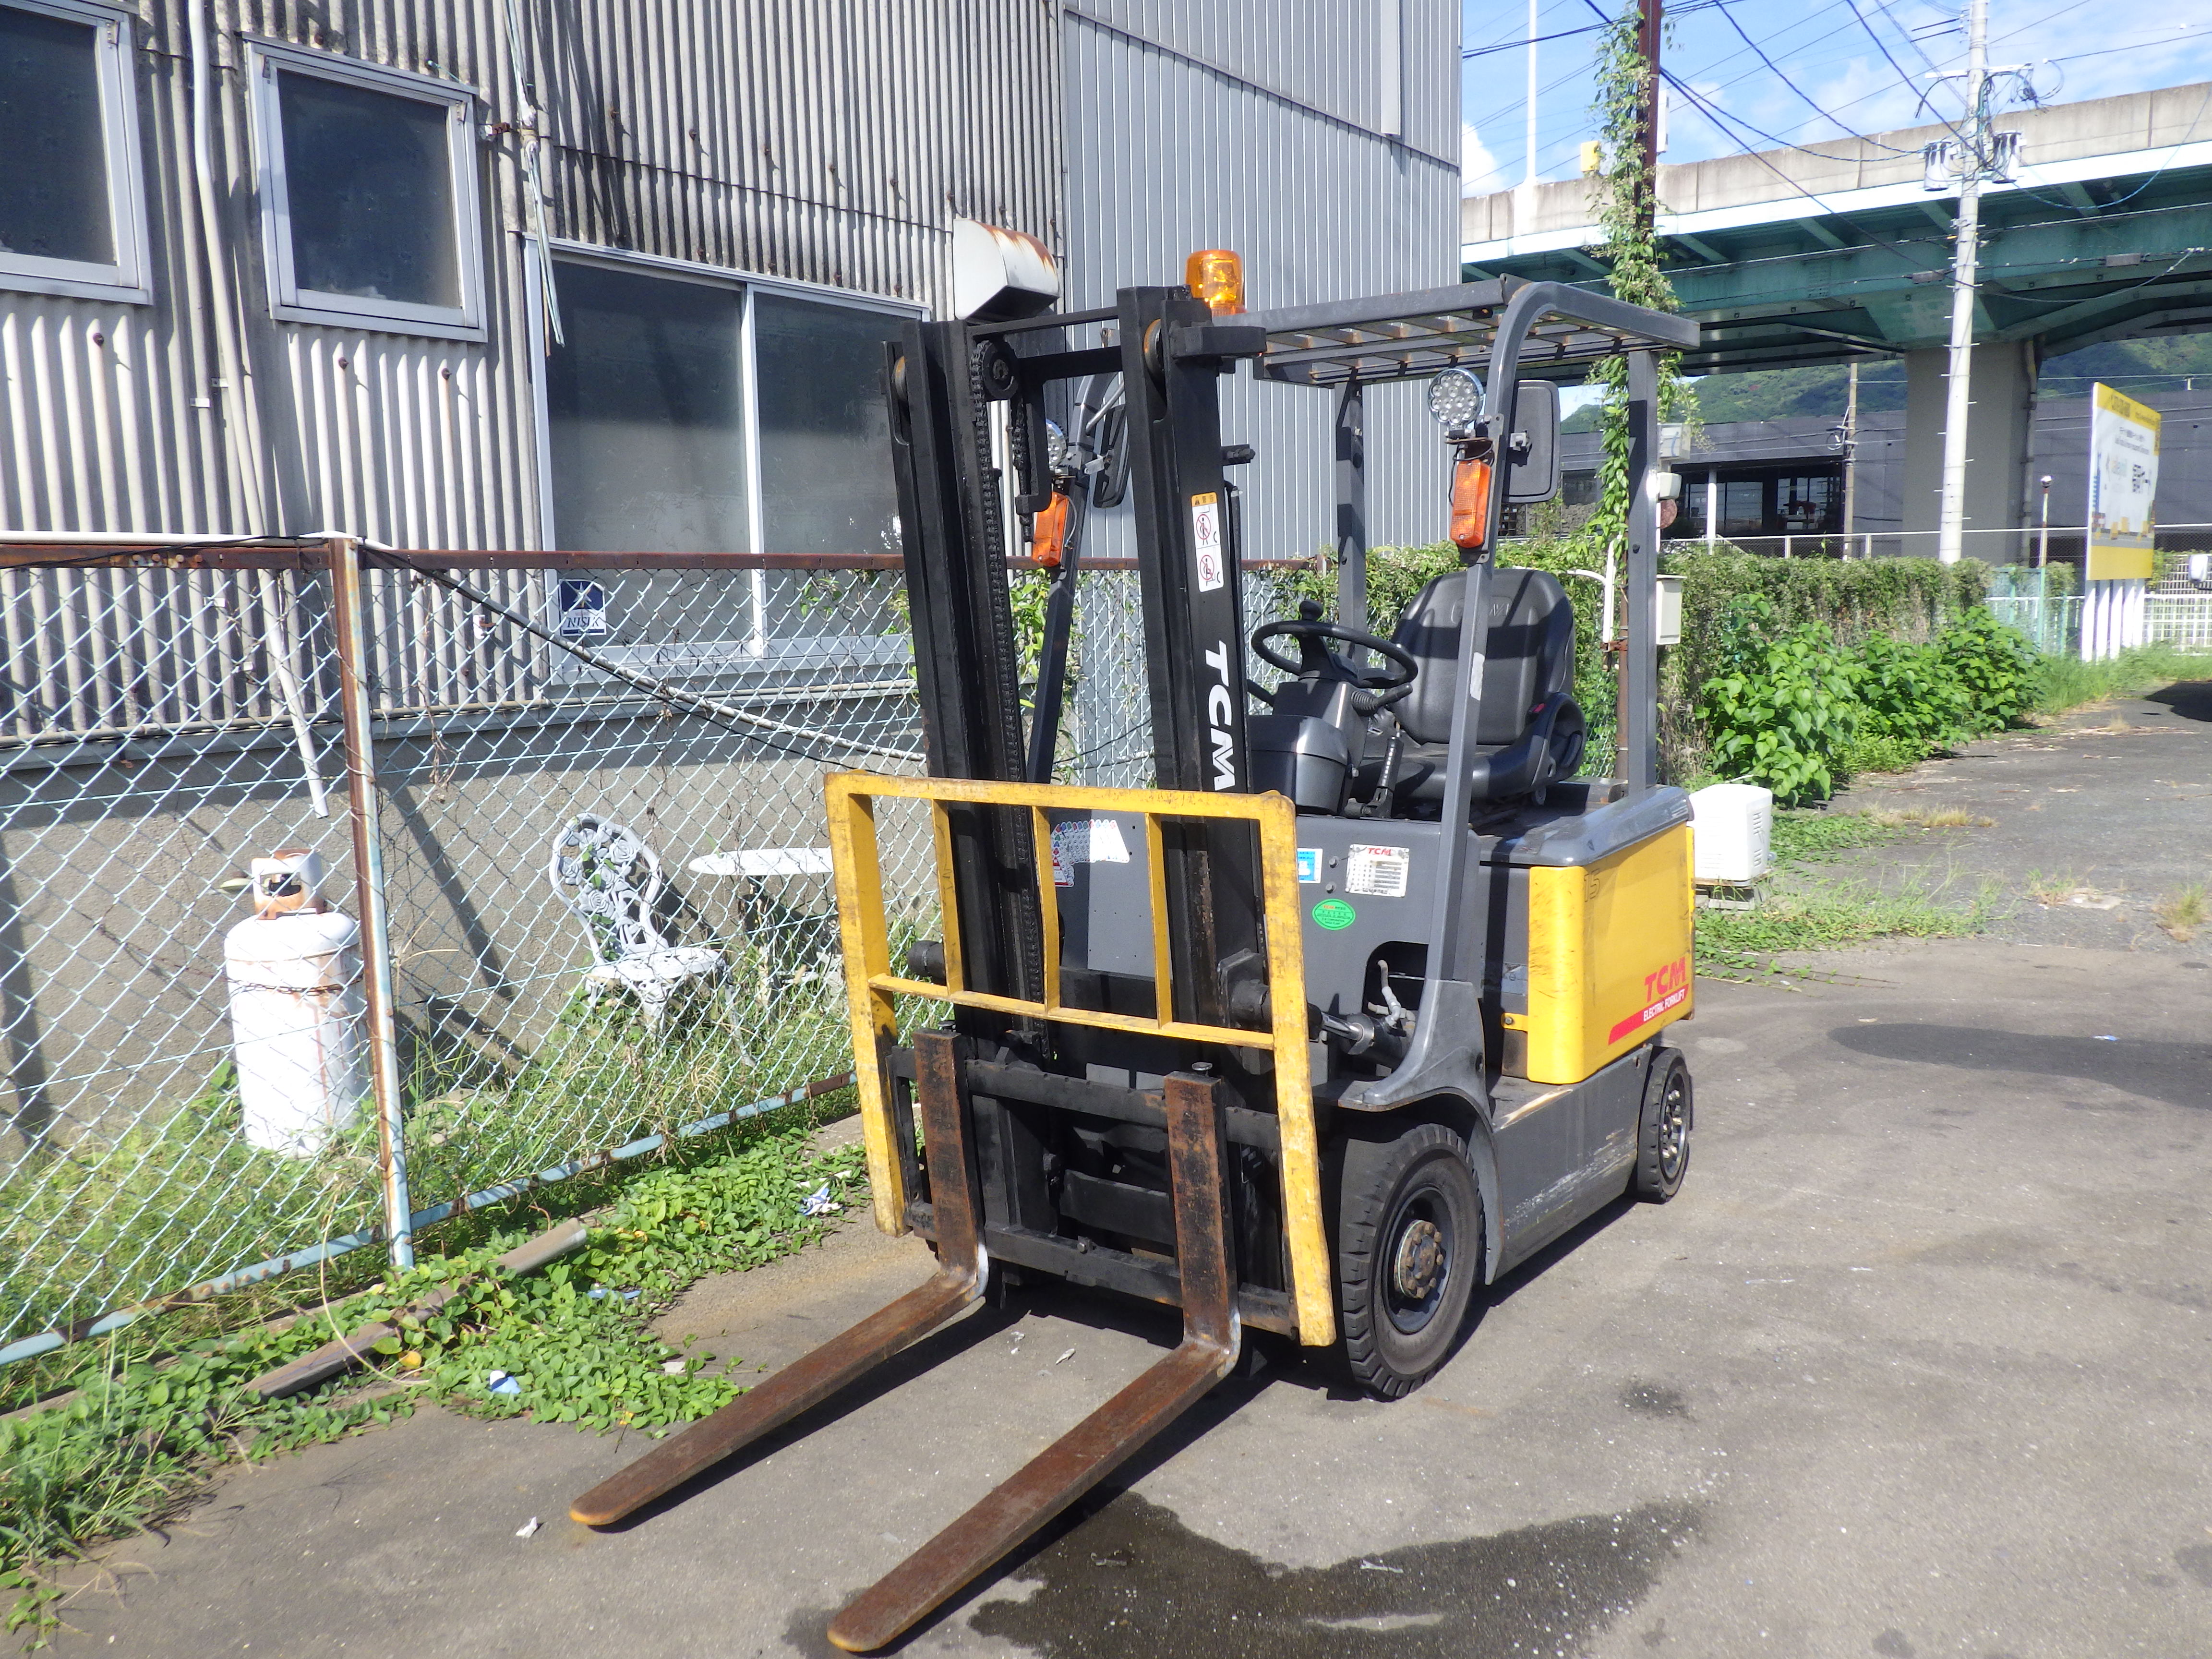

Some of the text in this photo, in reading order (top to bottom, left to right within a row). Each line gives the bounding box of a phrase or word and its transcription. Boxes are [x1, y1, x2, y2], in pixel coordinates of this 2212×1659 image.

[1205, 640, 1235, 791] TCM
[1368, 848, 1391, 856] TCM
[1645, 956, 1686, 1003] TCM
[1643, 989, 1685, 1022] ELECTRIC FORKLIFT
